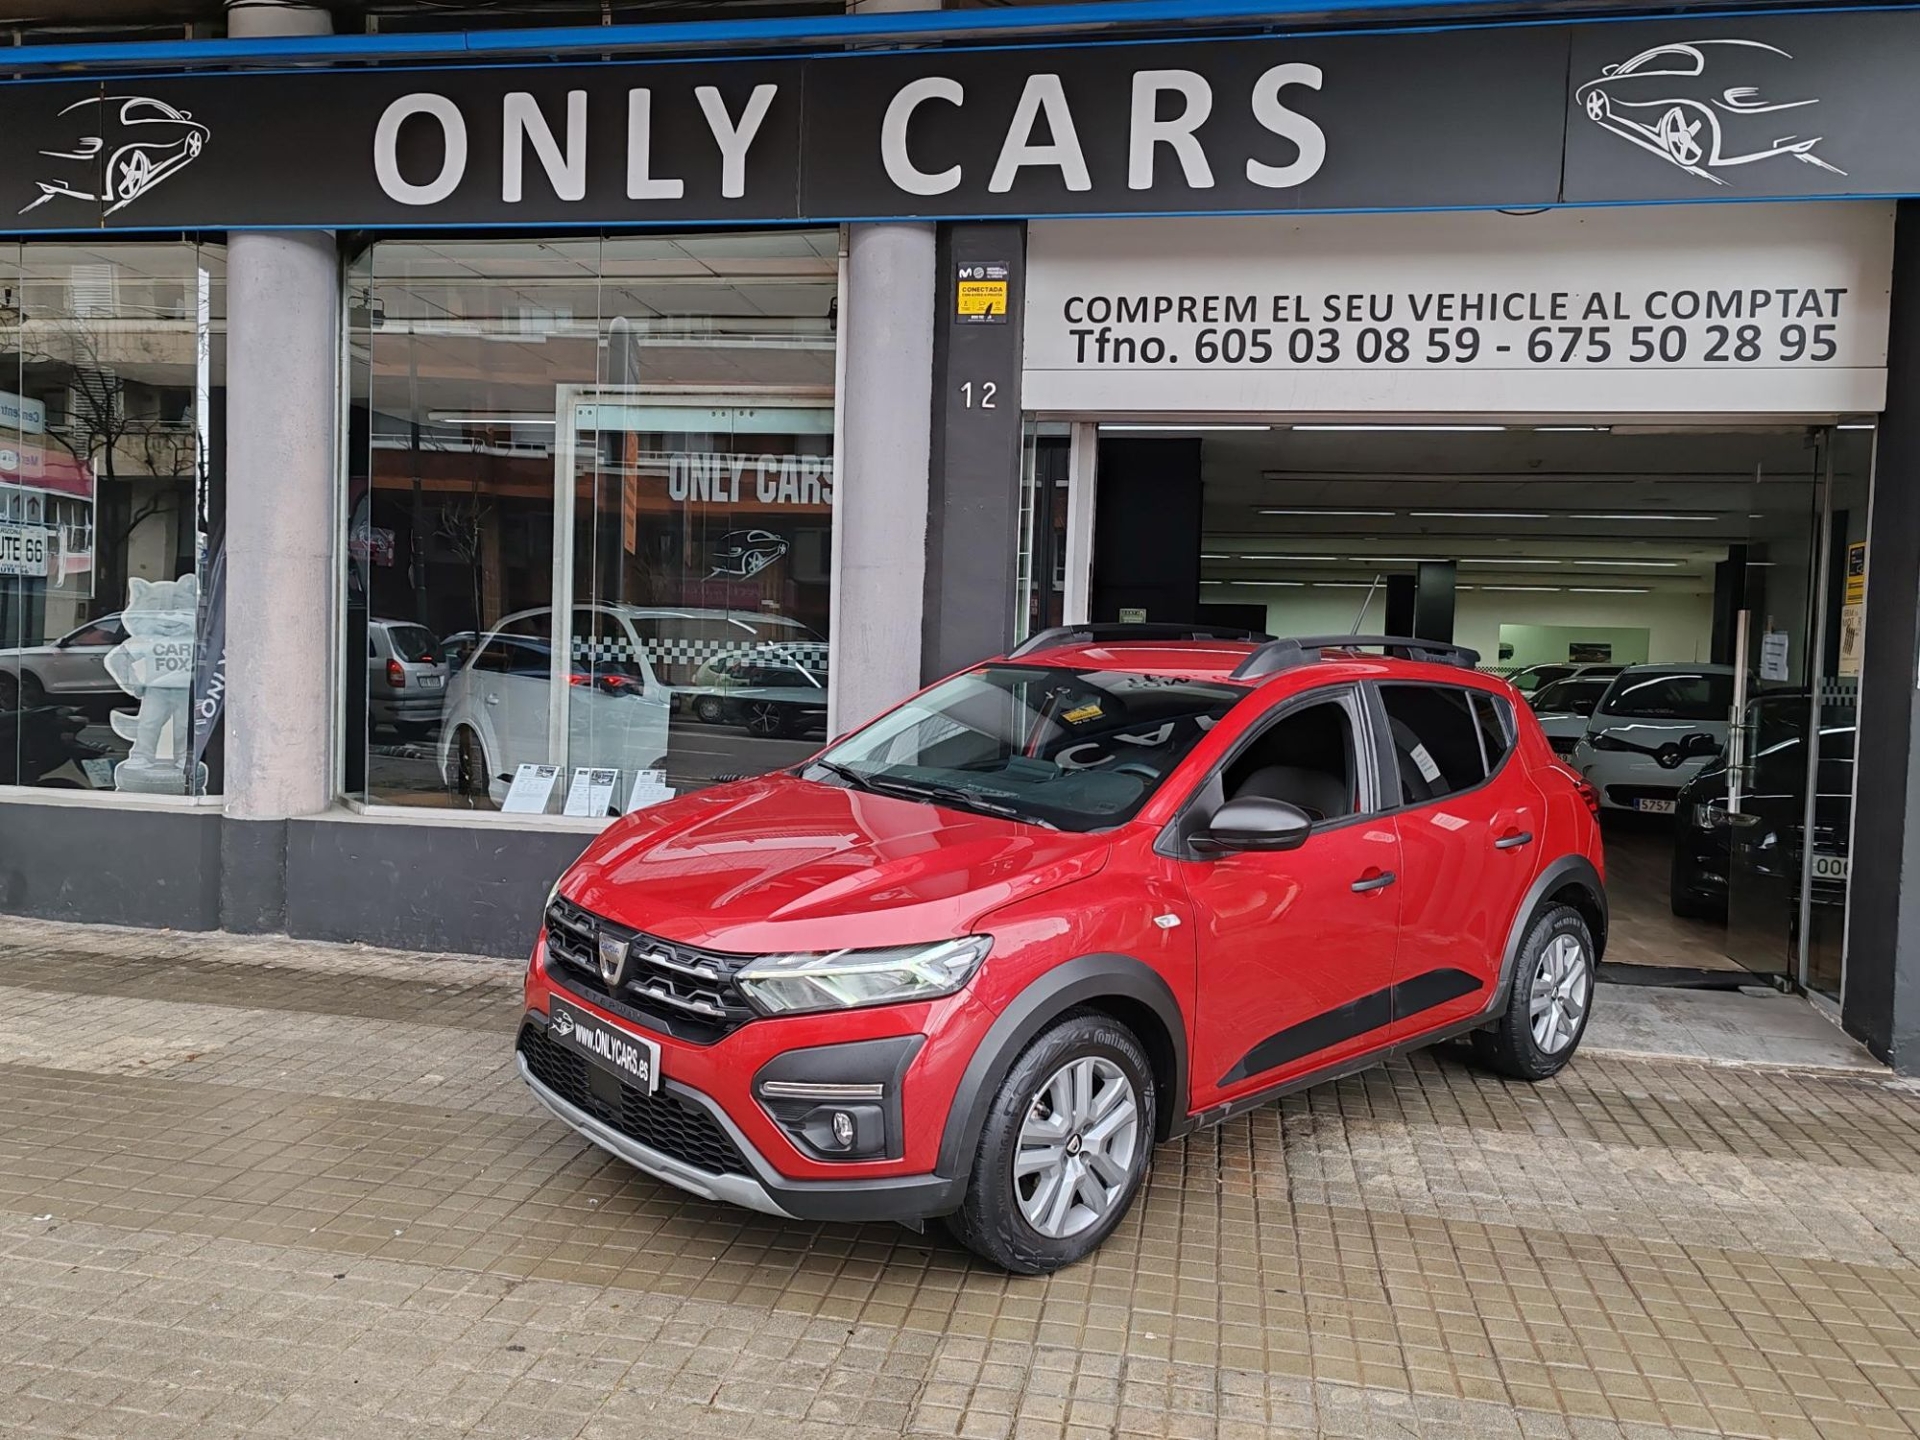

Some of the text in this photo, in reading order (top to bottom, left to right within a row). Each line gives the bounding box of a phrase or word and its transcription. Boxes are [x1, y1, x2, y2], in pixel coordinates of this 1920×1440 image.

[373, 62, 1327, 206] ONLY CARS
[1063, 287, 1848, 324] COMPREM EL SEU VEHICLE AL COMPTAT
[1068, 326, 1179, 364] Tfno.
[1194, 328, 1273, 364] 605
[1288, 327, 1341, 364] 03
[1355, 327, 1410, 364] 08
[1425, 326, 1480, 364] 59
[1527, 325, 1612, 363] 675
[1628, 325, 1688, 363] 50
[1702, 324, 1762, 362] 28
[1779, 323, 1838, 362] 95
[960, 381, 998, 408] 12
[668, 452, 834, 505] ONLY CARS
[26, 538, 43, 563] 66
[153, 643, 191, 657] CAR
[155, 657, 192, 671] FOX
[575, 1022, 649, 1082] www.ONLYCARS.es
